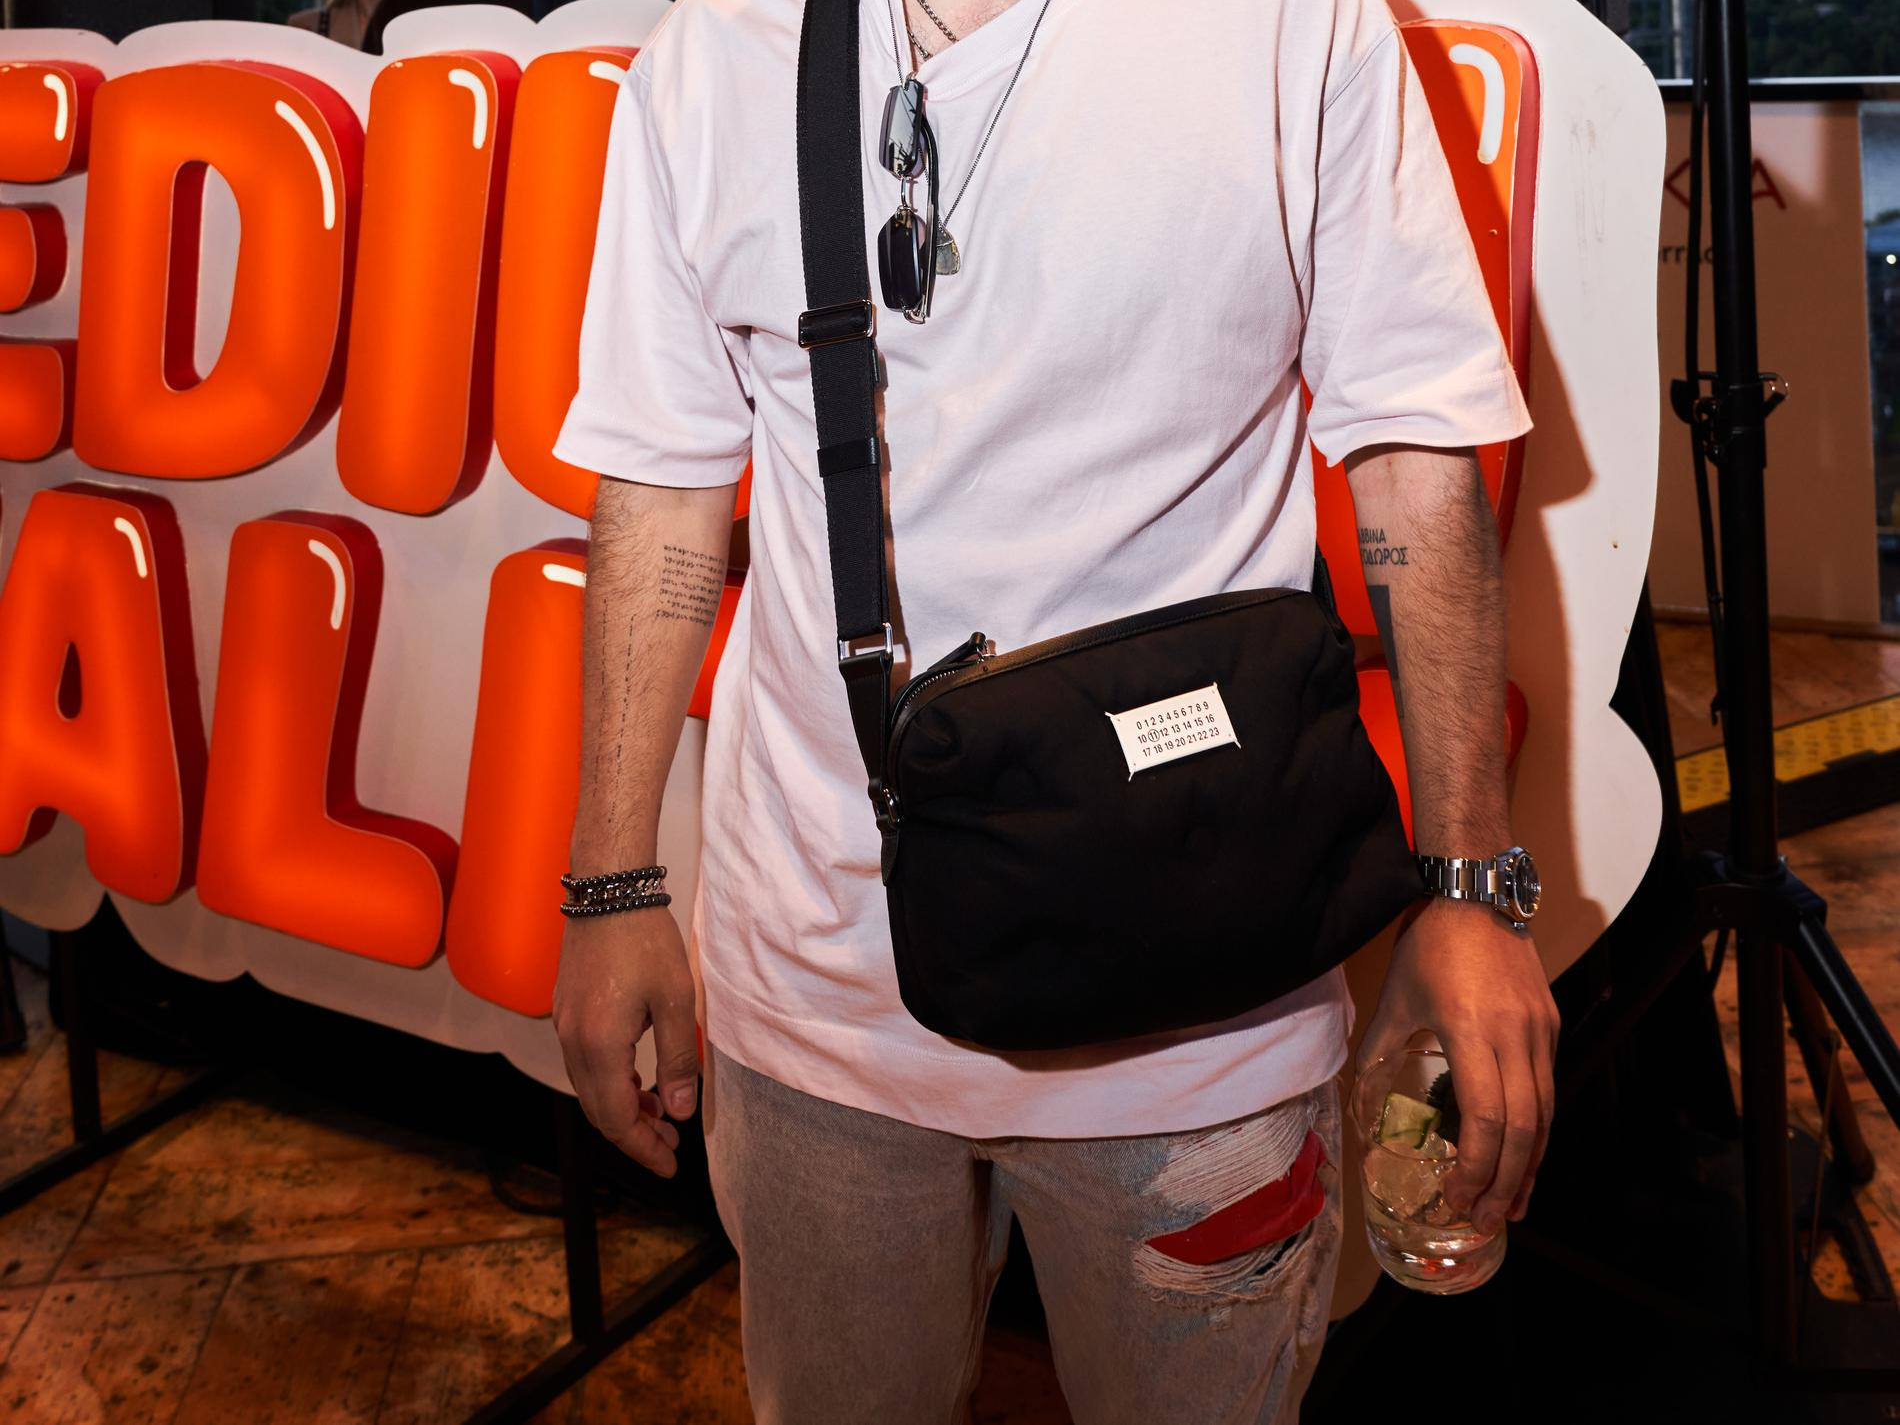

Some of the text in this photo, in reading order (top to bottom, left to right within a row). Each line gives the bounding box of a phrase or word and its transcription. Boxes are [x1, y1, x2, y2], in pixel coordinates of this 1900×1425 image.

[1136, 701, 1209, 730] 0 1 2 3 4 5 6 7 8 9
[1137, 714, 1215, 744] 10 11 12 13 14 15 16
[1142, 727, 1220, 757] 17 18 19 20 21 22 23
